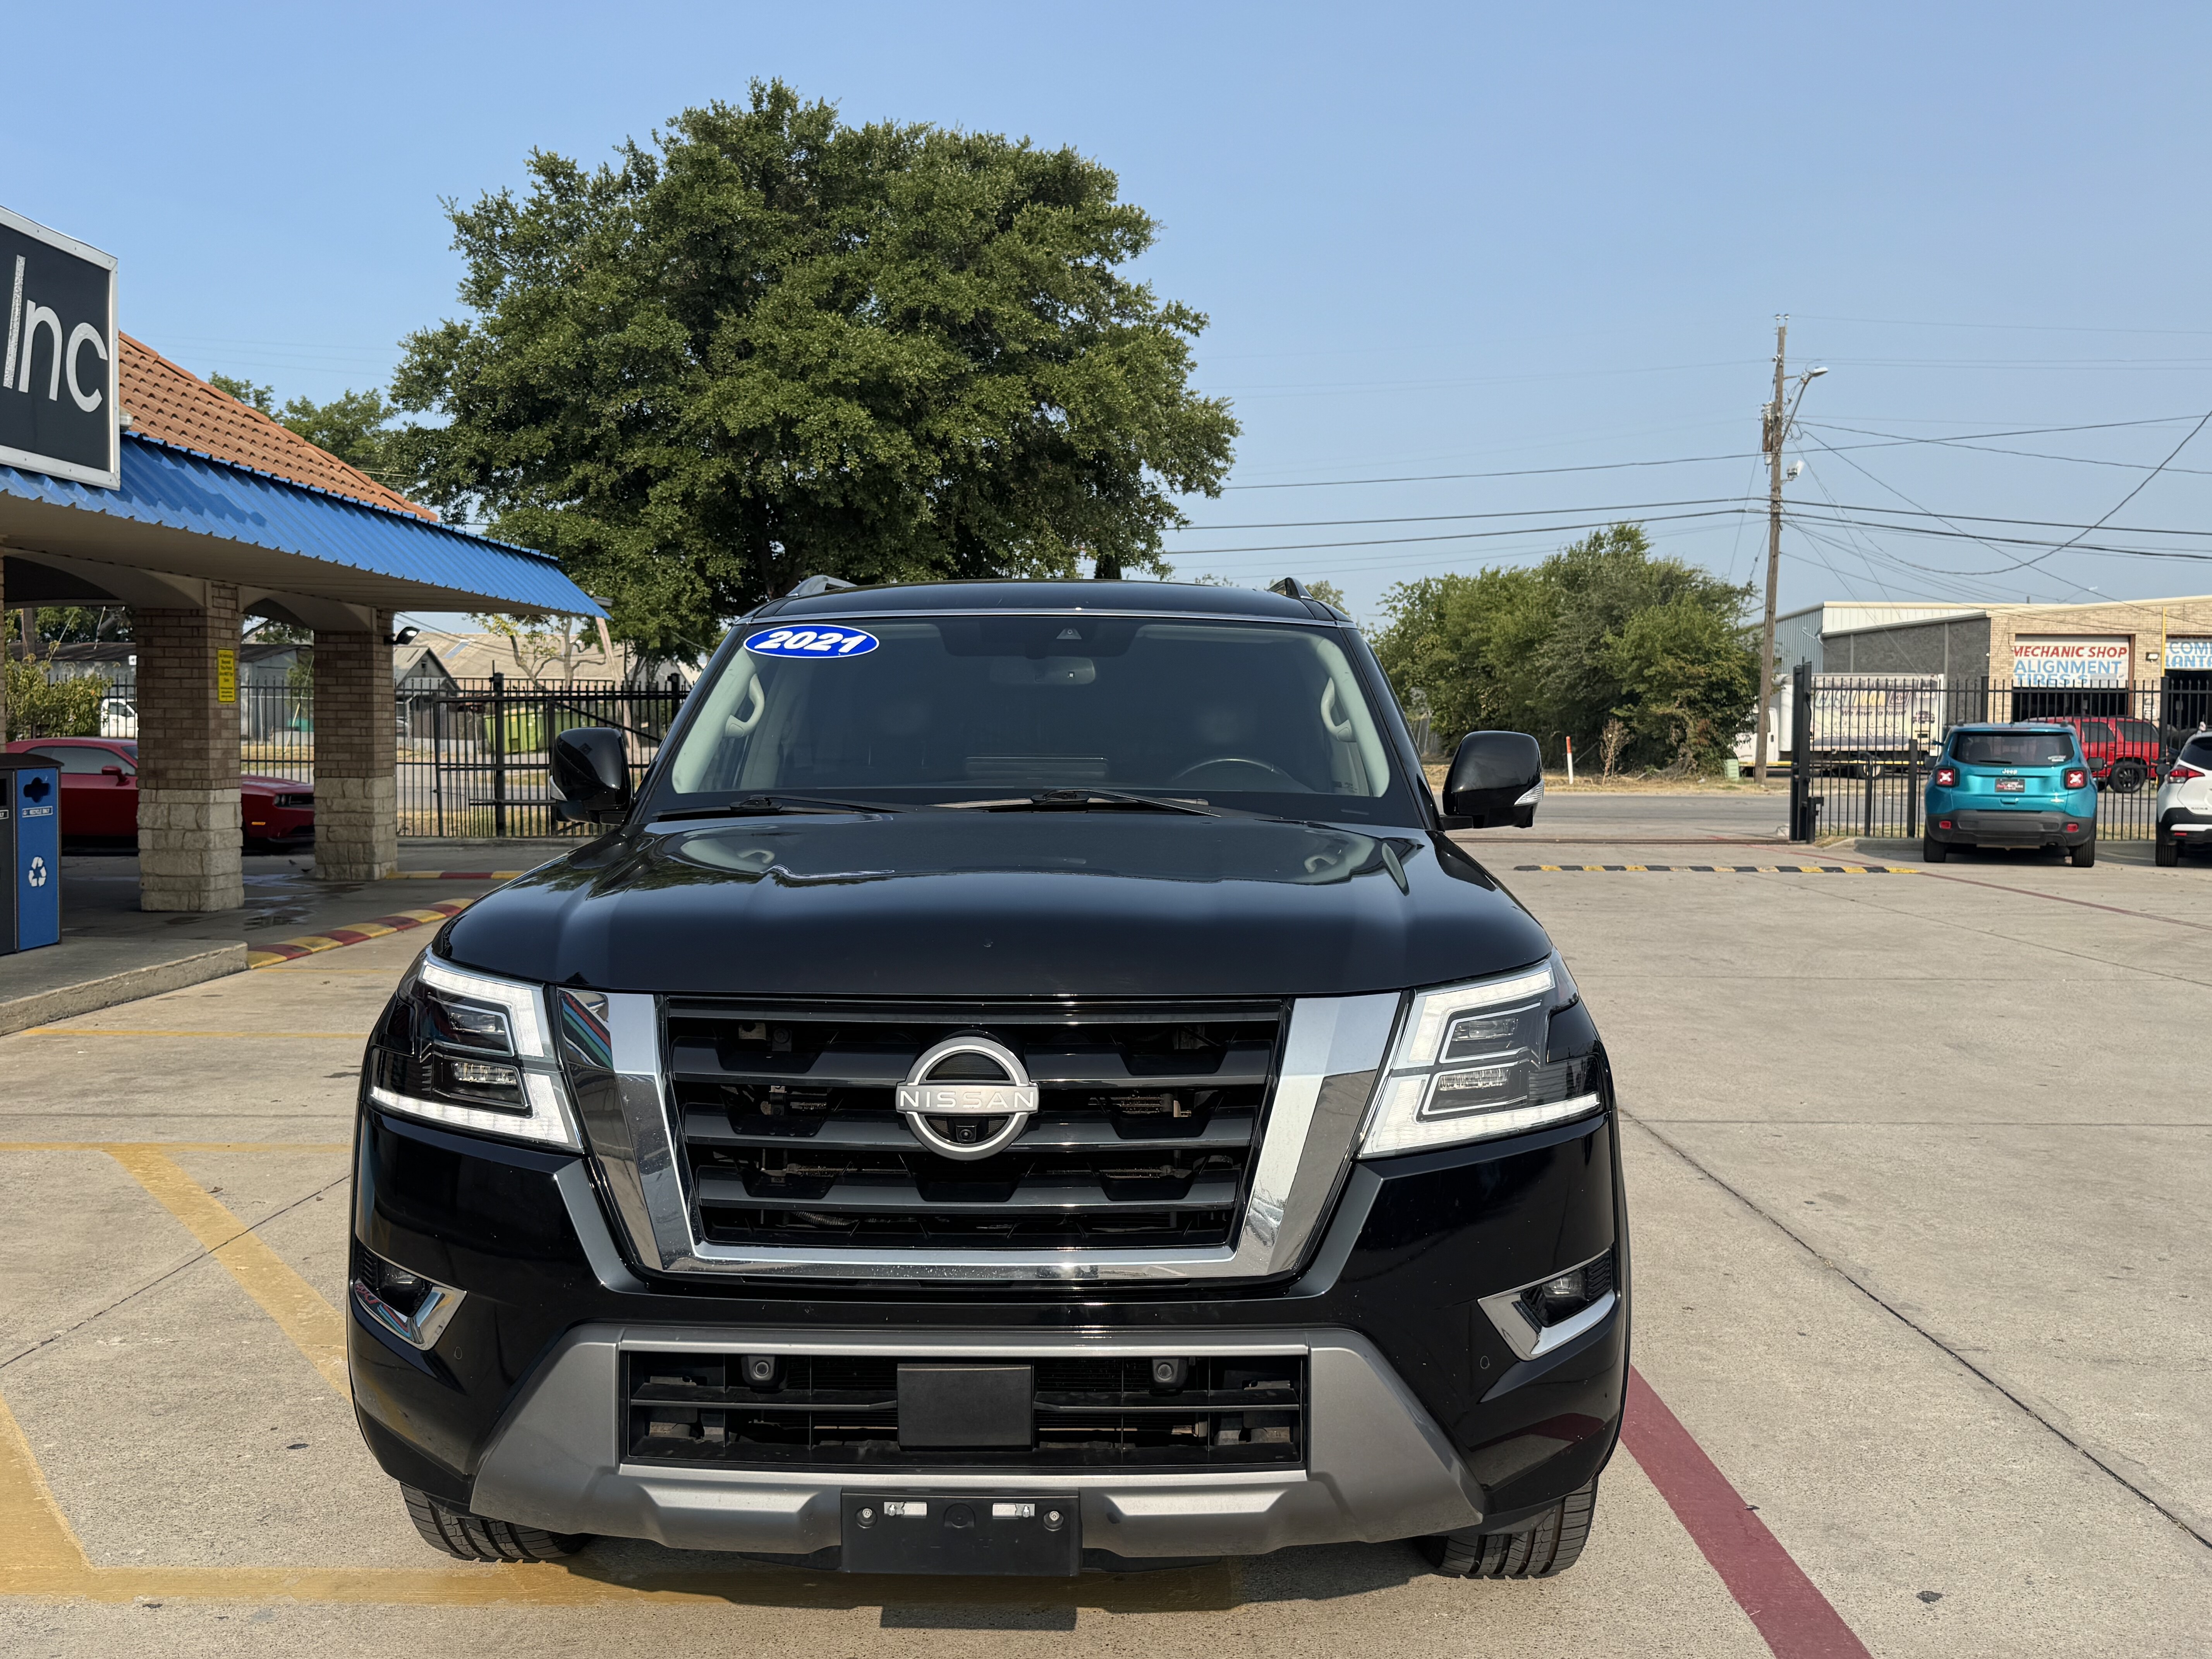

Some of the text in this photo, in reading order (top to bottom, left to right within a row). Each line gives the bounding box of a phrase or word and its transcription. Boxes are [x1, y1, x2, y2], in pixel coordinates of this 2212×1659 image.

[3, 254, 108, 412] Inc
[754, 631, 867, 653] 2021
[2014, 646, 2127, 658] MECHANIC SHOP
[2013, 660, 2122, 674] ALIGNMENT
[2014, 674, 2071, 685] TIRES
[900, 1090, 1034, 1108] NISSAN
